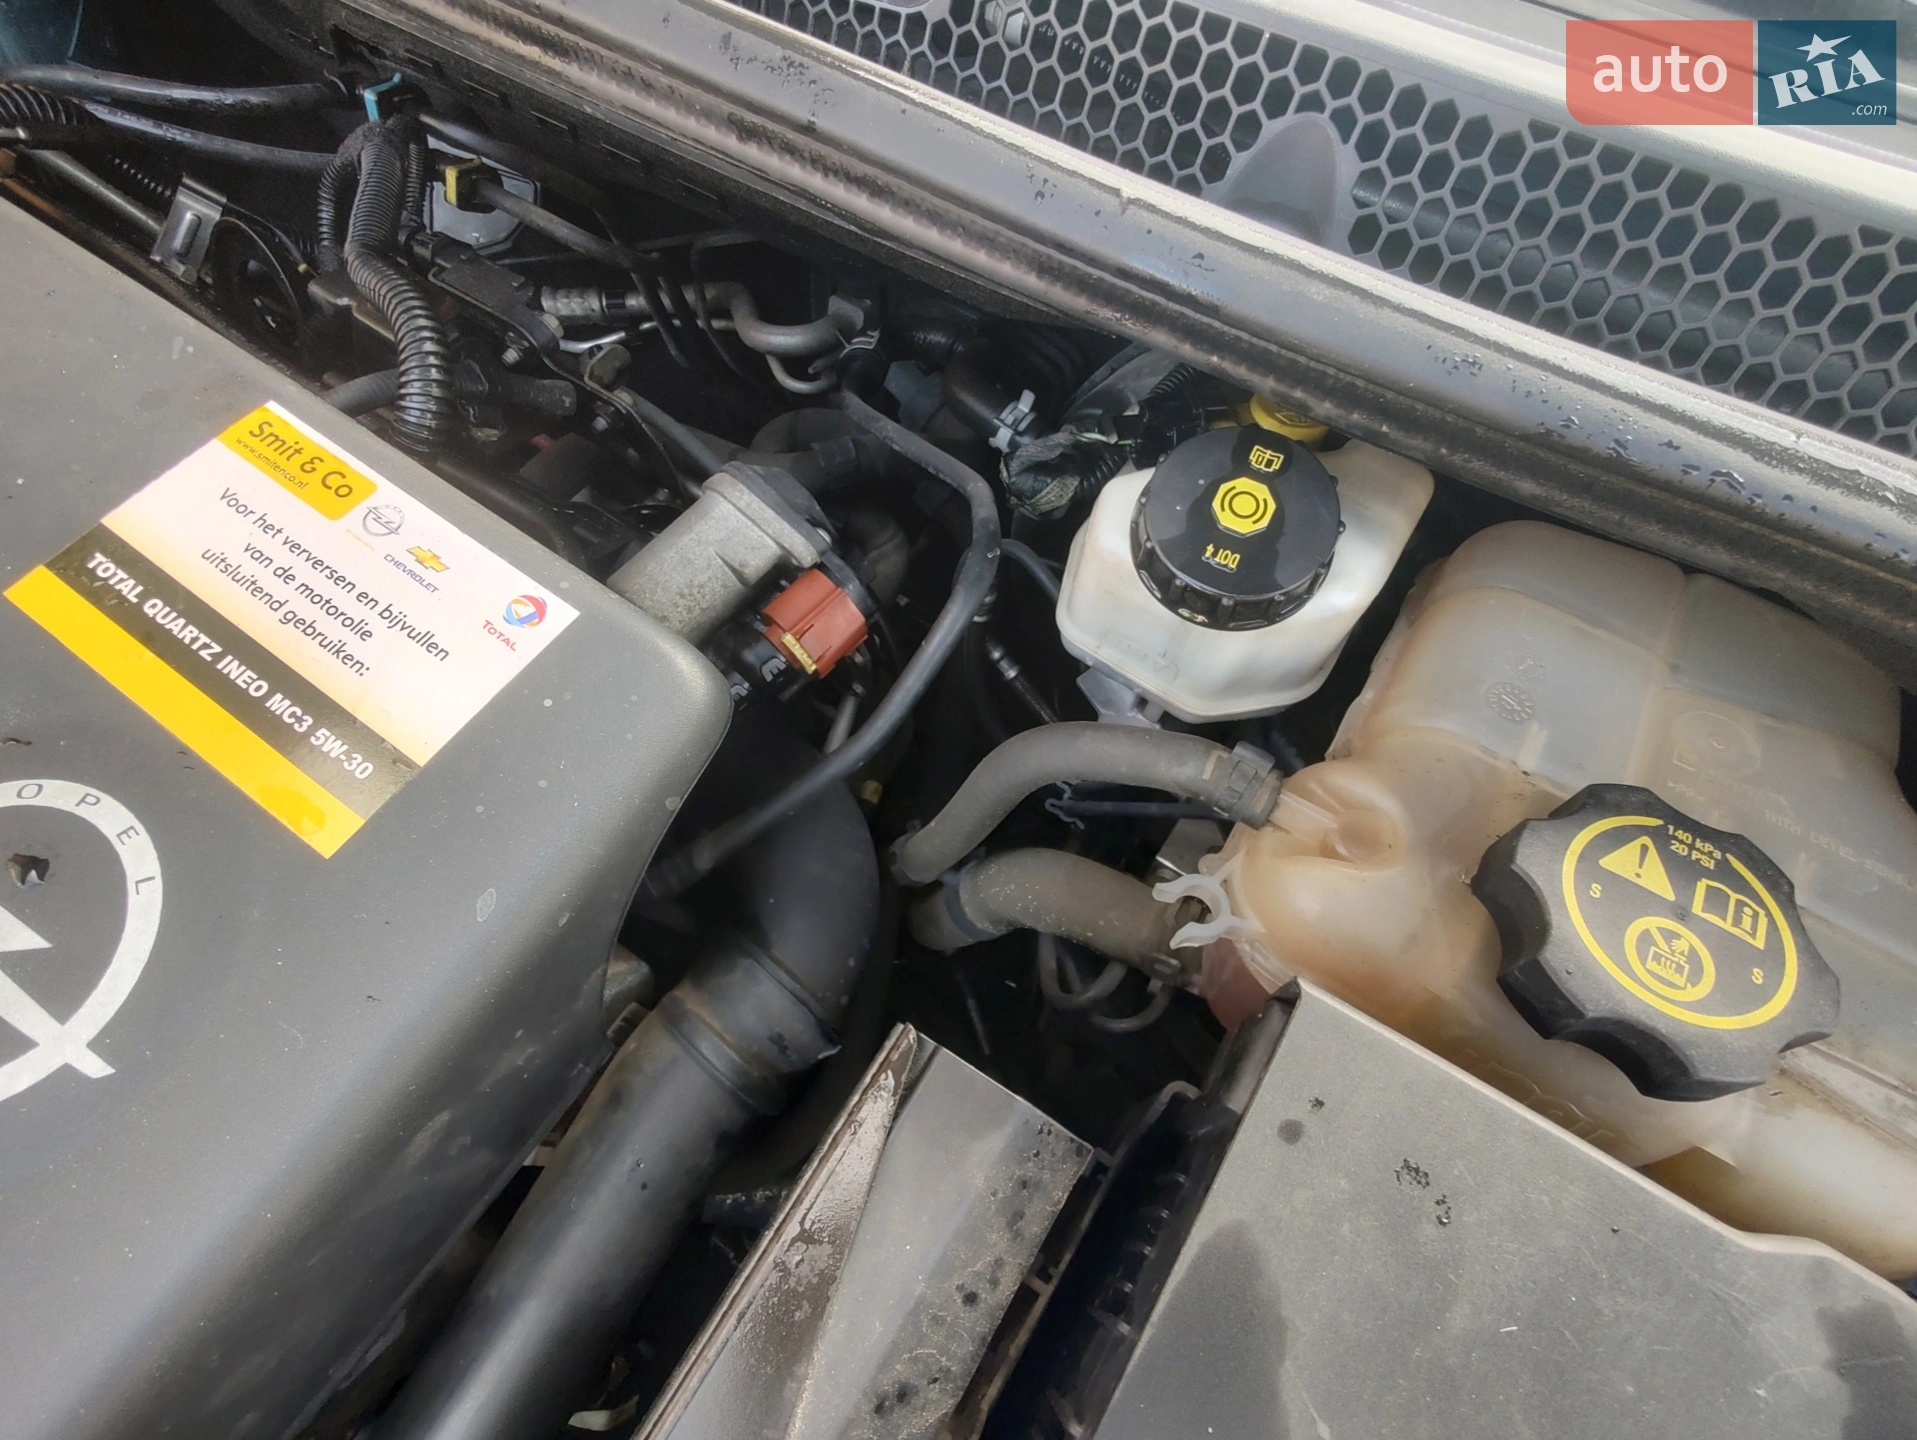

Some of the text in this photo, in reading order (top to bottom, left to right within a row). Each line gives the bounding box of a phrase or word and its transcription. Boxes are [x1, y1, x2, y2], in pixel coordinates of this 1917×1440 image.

[235, 437, 310, 490] www.smitenco.nl
[248, 420, 354, 498] Smit & Co
[219, 487, 255, 519] Voor
[252, 513, 283, 540] het
[282, 535, 356, 594] verversen
[356, 590, 379, 612] en
[378, 603, 450, 662] bijvullen
[383, 553, 440, 595] CHEVROLET
[1204, 543, 1240, 569] DOT 4
[200, 548, 371, 677] uitsluitend gebruiken:
[243, 542, 373, 642] van de motorolie
[482, 620, 517, 652] TOTAL
[86, 552, 374, 780] TOTAL QUARTZ INEO MC3 5W-30
[16, 783, 156, 896] OPEL
[1667, 824, 1722, 859] 140 kPa
[1669, 840, 1715, 870] 20 PSI
[1589, 883, 1603, 899] S
[1751, 967, 1764, 985] S
